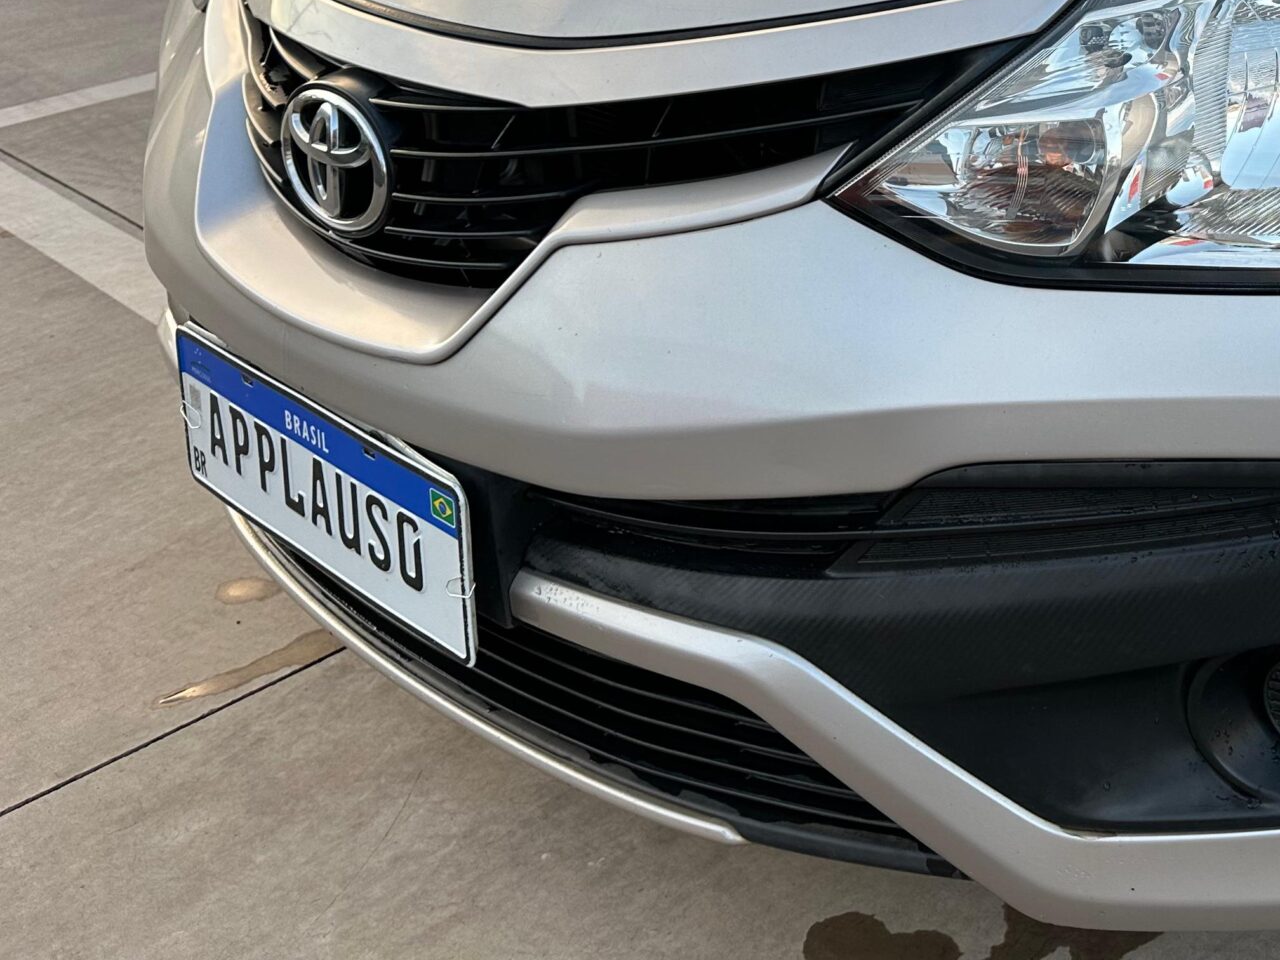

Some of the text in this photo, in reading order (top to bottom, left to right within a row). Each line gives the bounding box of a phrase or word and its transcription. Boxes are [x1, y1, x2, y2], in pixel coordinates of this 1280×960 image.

[283, 409, 329, 454] BRASIL
[193, 446, 207, 478] BR
[209, 389, 424, 592] APPLAUSO
